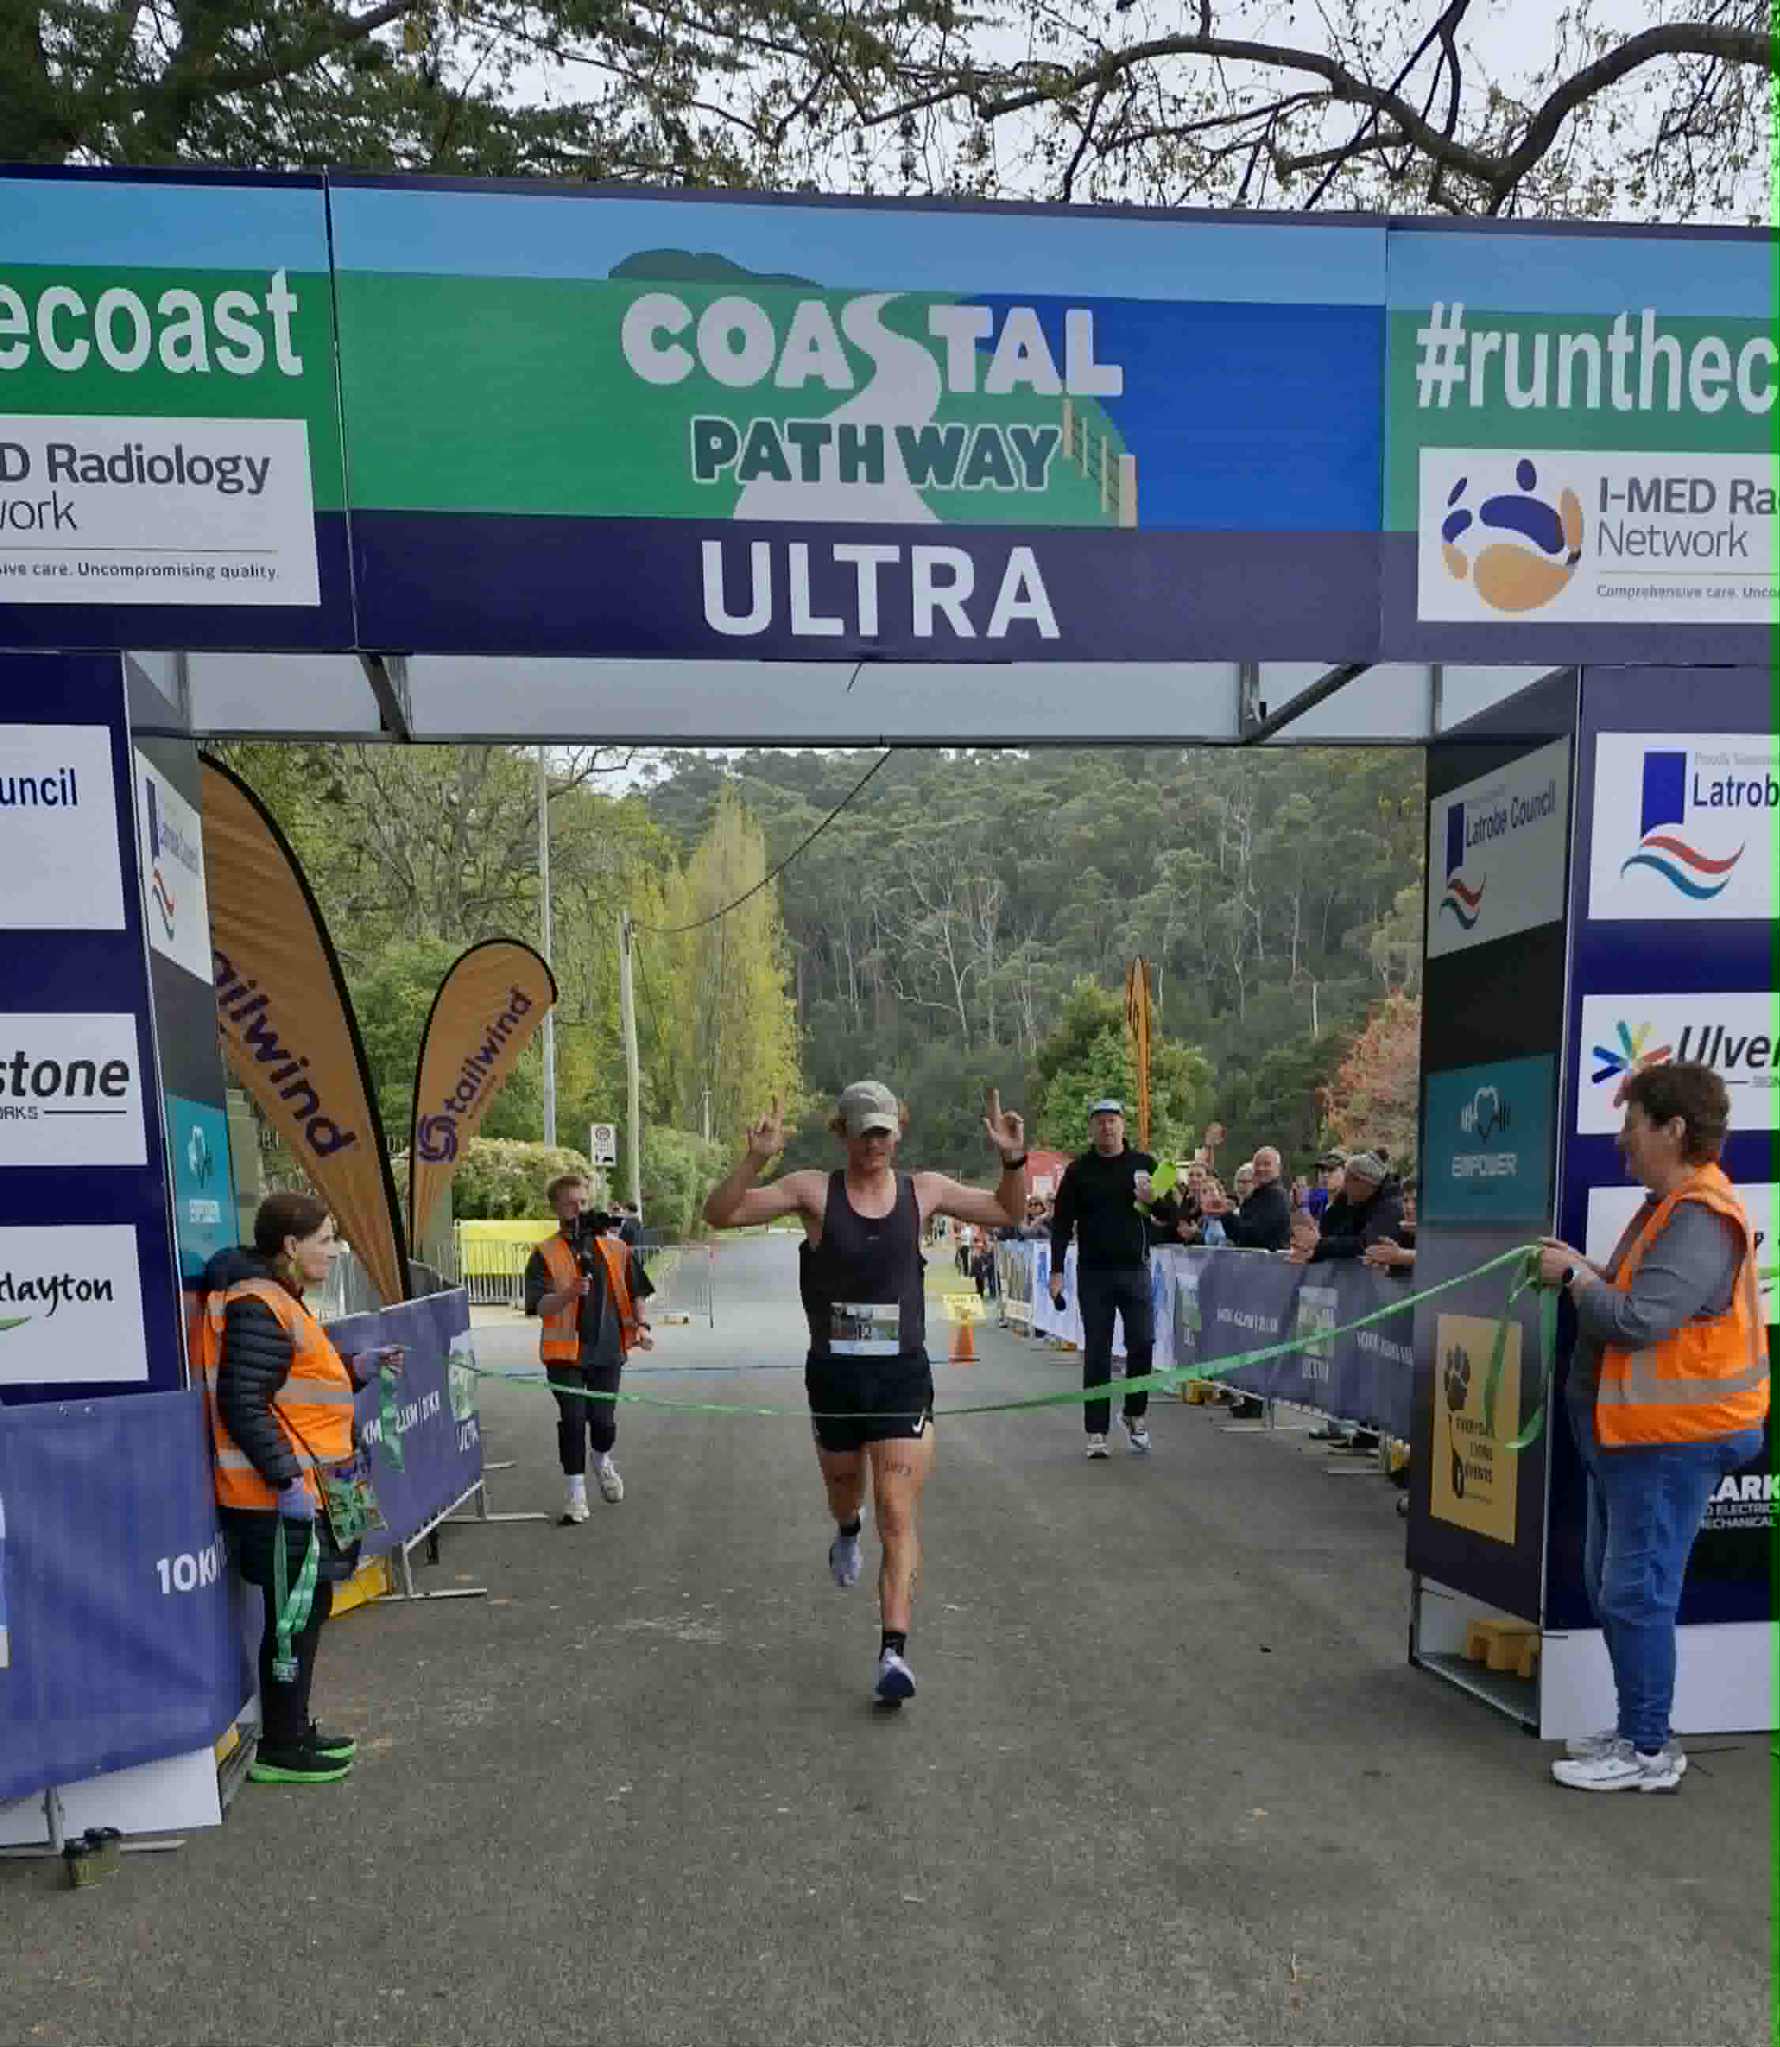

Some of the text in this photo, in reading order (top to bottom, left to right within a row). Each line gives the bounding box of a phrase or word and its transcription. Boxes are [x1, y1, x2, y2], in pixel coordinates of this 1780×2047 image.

[621, 291, 1124, 398] COASTAL
[46, 443, 271, 495] Radiology
[690, 415, 1062, 491] PATHWAY
[1600, 477, 1717, 513] I-MED
[1598, 518, 1749, 557] Network
[33, 564, 73, 576] care.
[78, 561, 215, 580] Uncompromising
[220, 564, 279, 581] quality.
[702, 540, 1060, 638] ULTRA
[1597, 584, 1702, 600] Comprehensive
[443, 983, 533, 1114] tailwind
